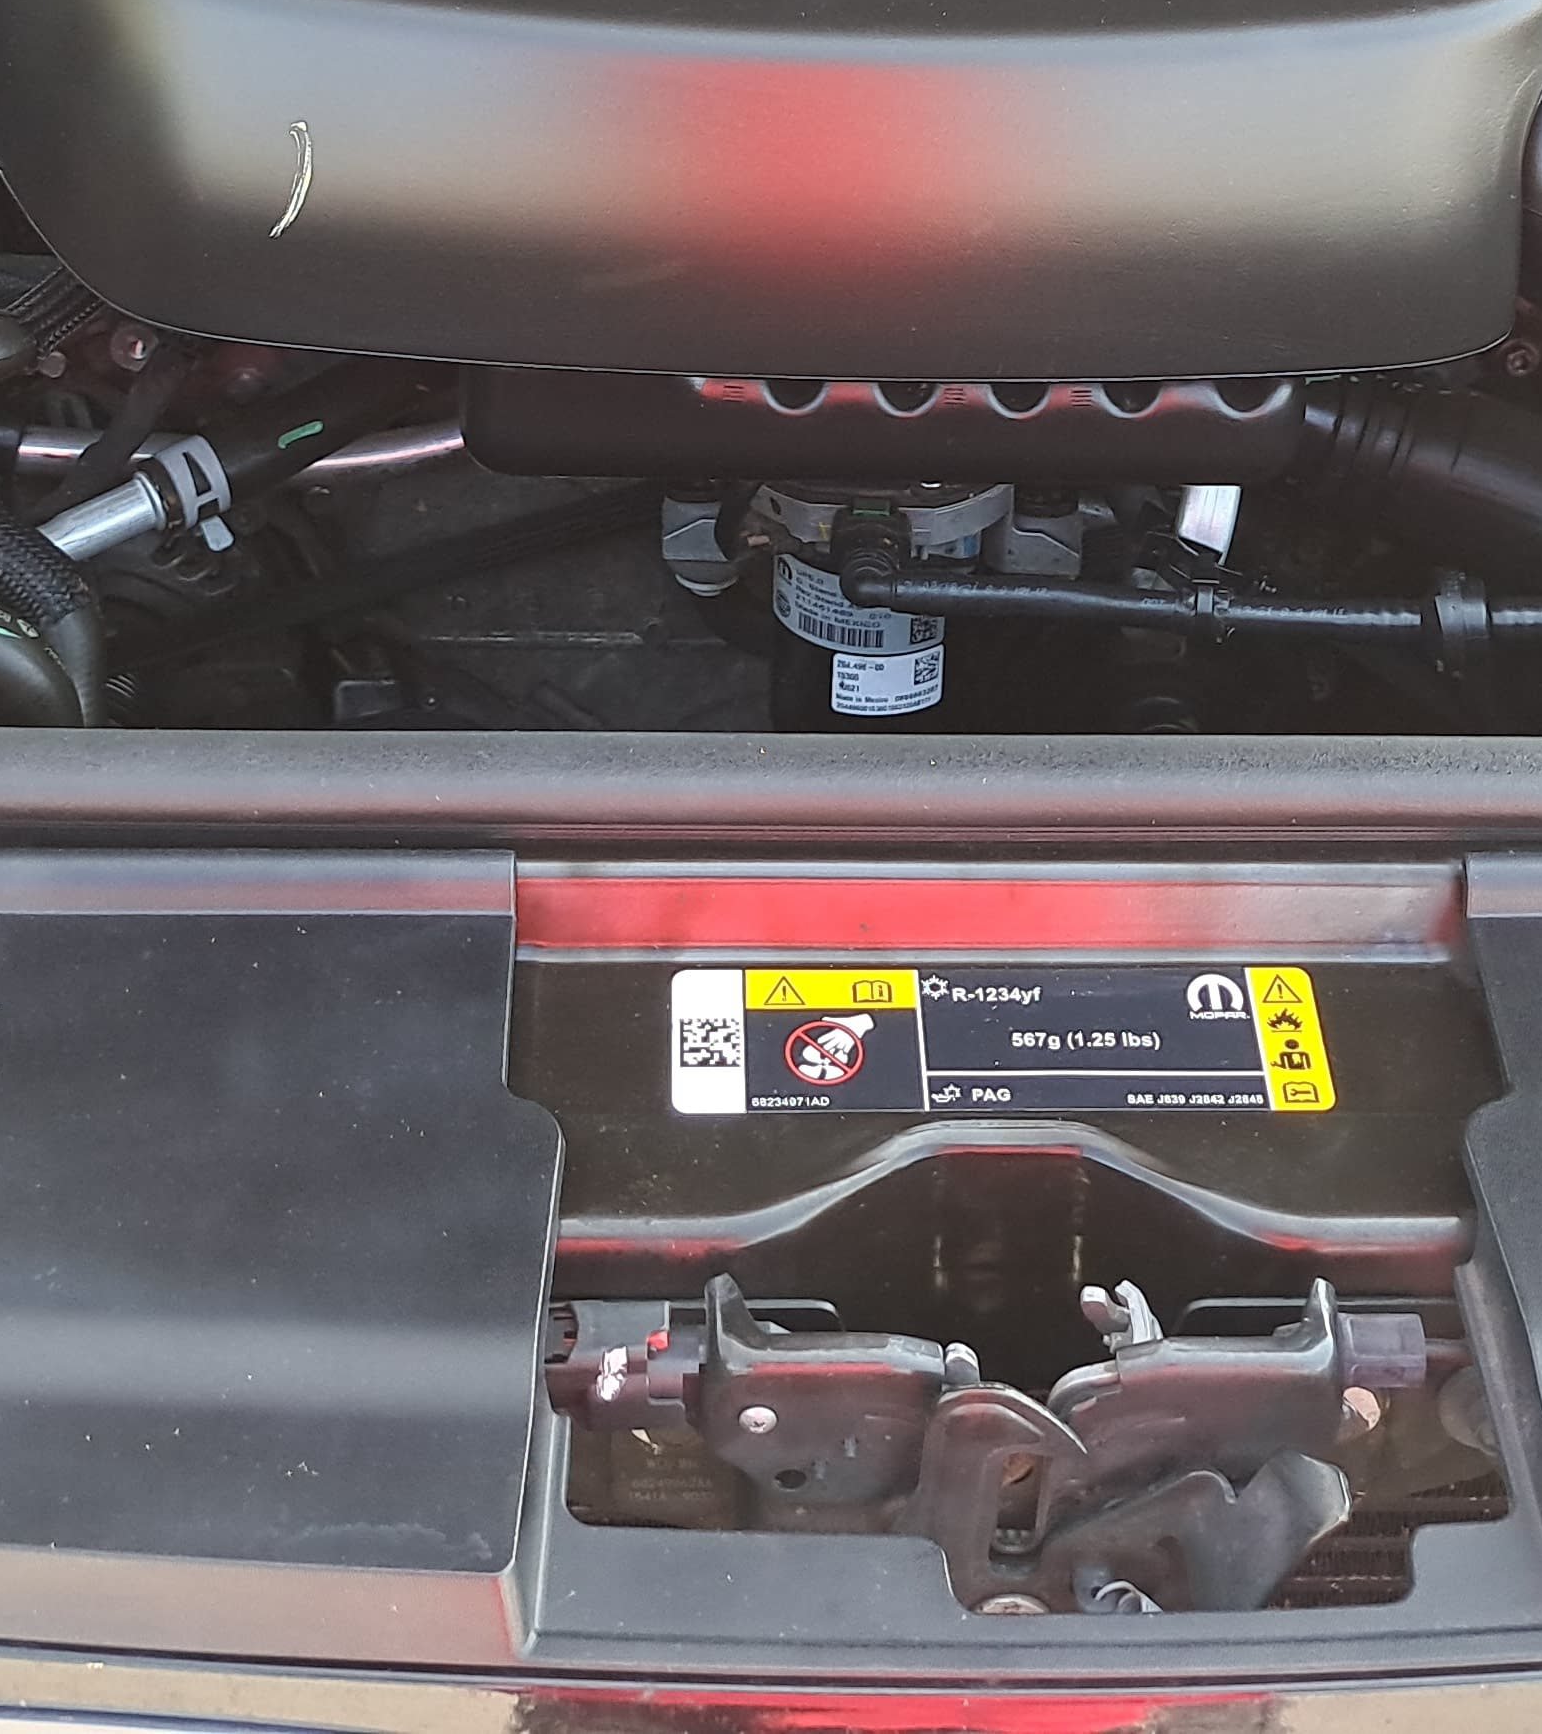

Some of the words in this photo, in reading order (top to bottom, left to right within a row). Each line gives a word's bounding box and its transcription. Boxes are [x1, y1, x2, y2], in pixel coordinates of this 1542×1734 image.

[952, 987, 1042, 1005] R-1234yf
[1011, 1031, 1061, 1050] 567g
[1067, 1030, 1116, 1050] (1.25
[1122, 1031, 1162, 1050] lbs)
[971, 1088, 1011, 1102] PAG
[1127, 1094, 1154, 1104] SAE
